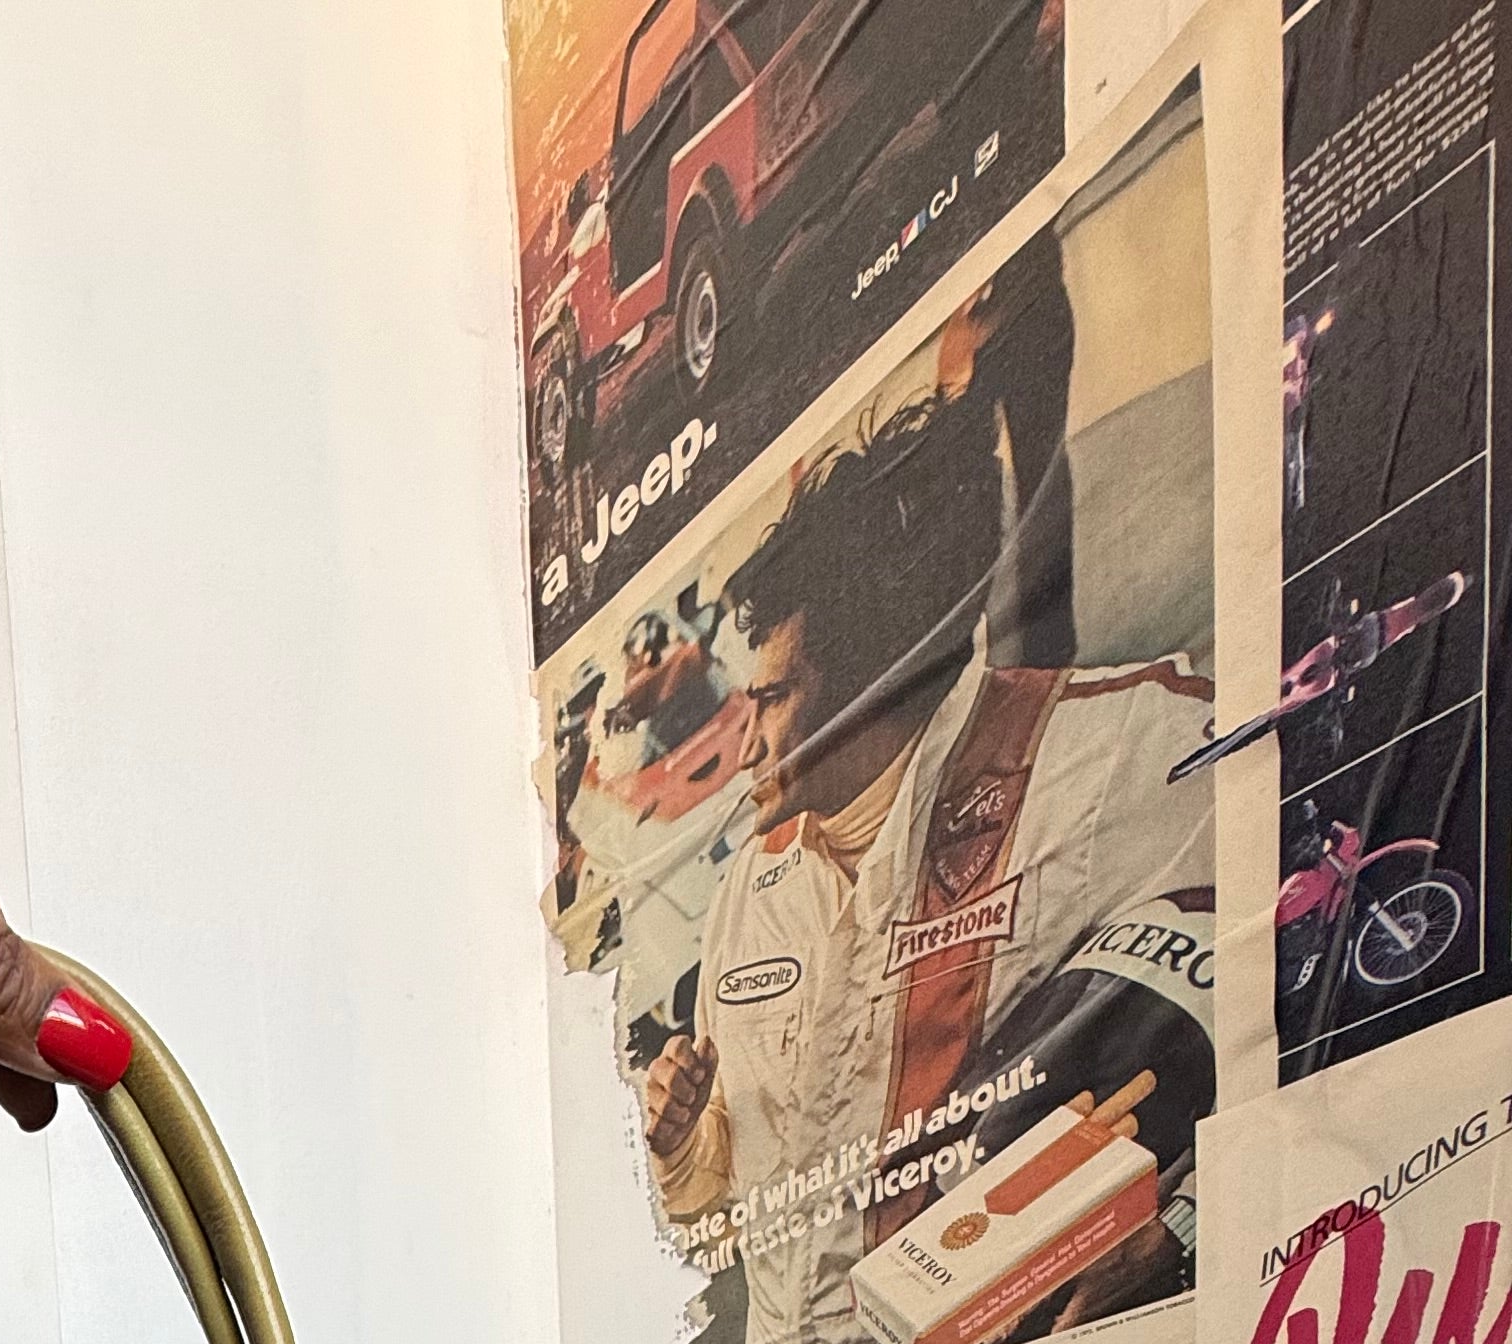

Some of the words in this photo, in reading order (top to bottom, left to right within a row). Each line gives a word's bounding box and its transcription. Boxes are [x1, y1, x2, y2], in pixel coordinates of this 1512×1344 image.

[929, 175, 958, 220] CJ
[542, 555, 568, 606] a
[582, 418, 717, 563] Jeep.
[896, 901, 1006, 961] Firestone
[721, 967, 792, 994] Samsonite
[676, 1215, 726, 1251] aste
[730, 1186, 760, 1228] of
[763, 1159, 835, 1212] what
[837, 1135, 880, 1178] it's
[883, 1107, 923, 1156] all
[926, 1055, 1047, 1134] about.
[738, 1212, 808, 1262] taste
[813, 1184, 847, 1229] of
[851, 1132, 985, 1212] Viceroy.
[1260, 1109, 1490, 1282] INTRODUCING
[898, 1237, 957, 1287] VICEROY
